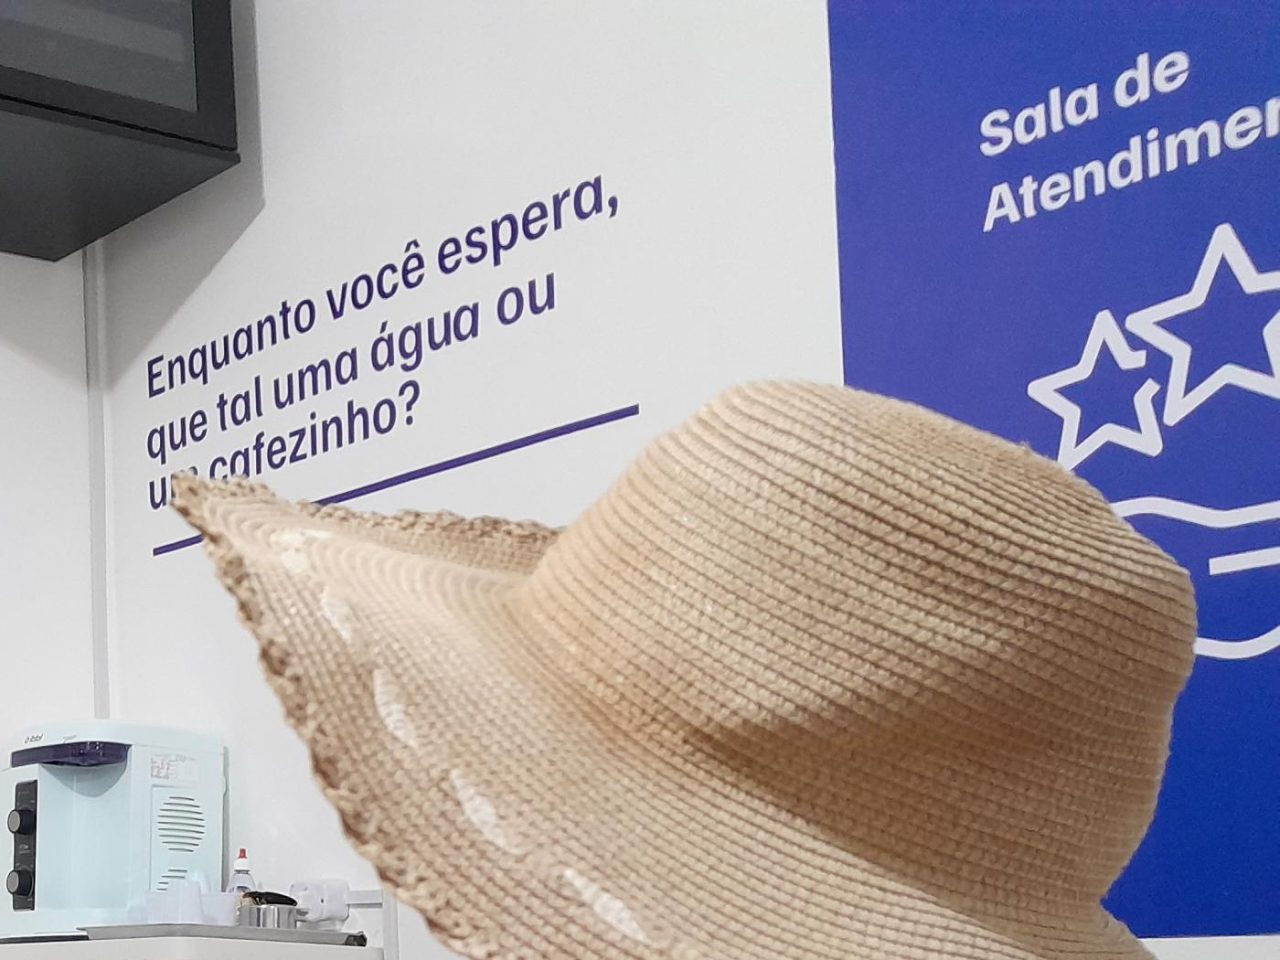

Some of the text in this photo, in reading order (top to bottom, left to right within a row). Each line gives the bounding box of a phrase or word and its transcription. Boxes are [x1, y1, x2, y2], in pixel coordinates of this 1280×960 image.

[979, 51, 1190, 156] Sala de
[146, 175, 619, 398] Enquanto você espera,
[146, 272, 556, 466] que tal uma água ou
[148, 380, 422, 510] u cafezinho?
